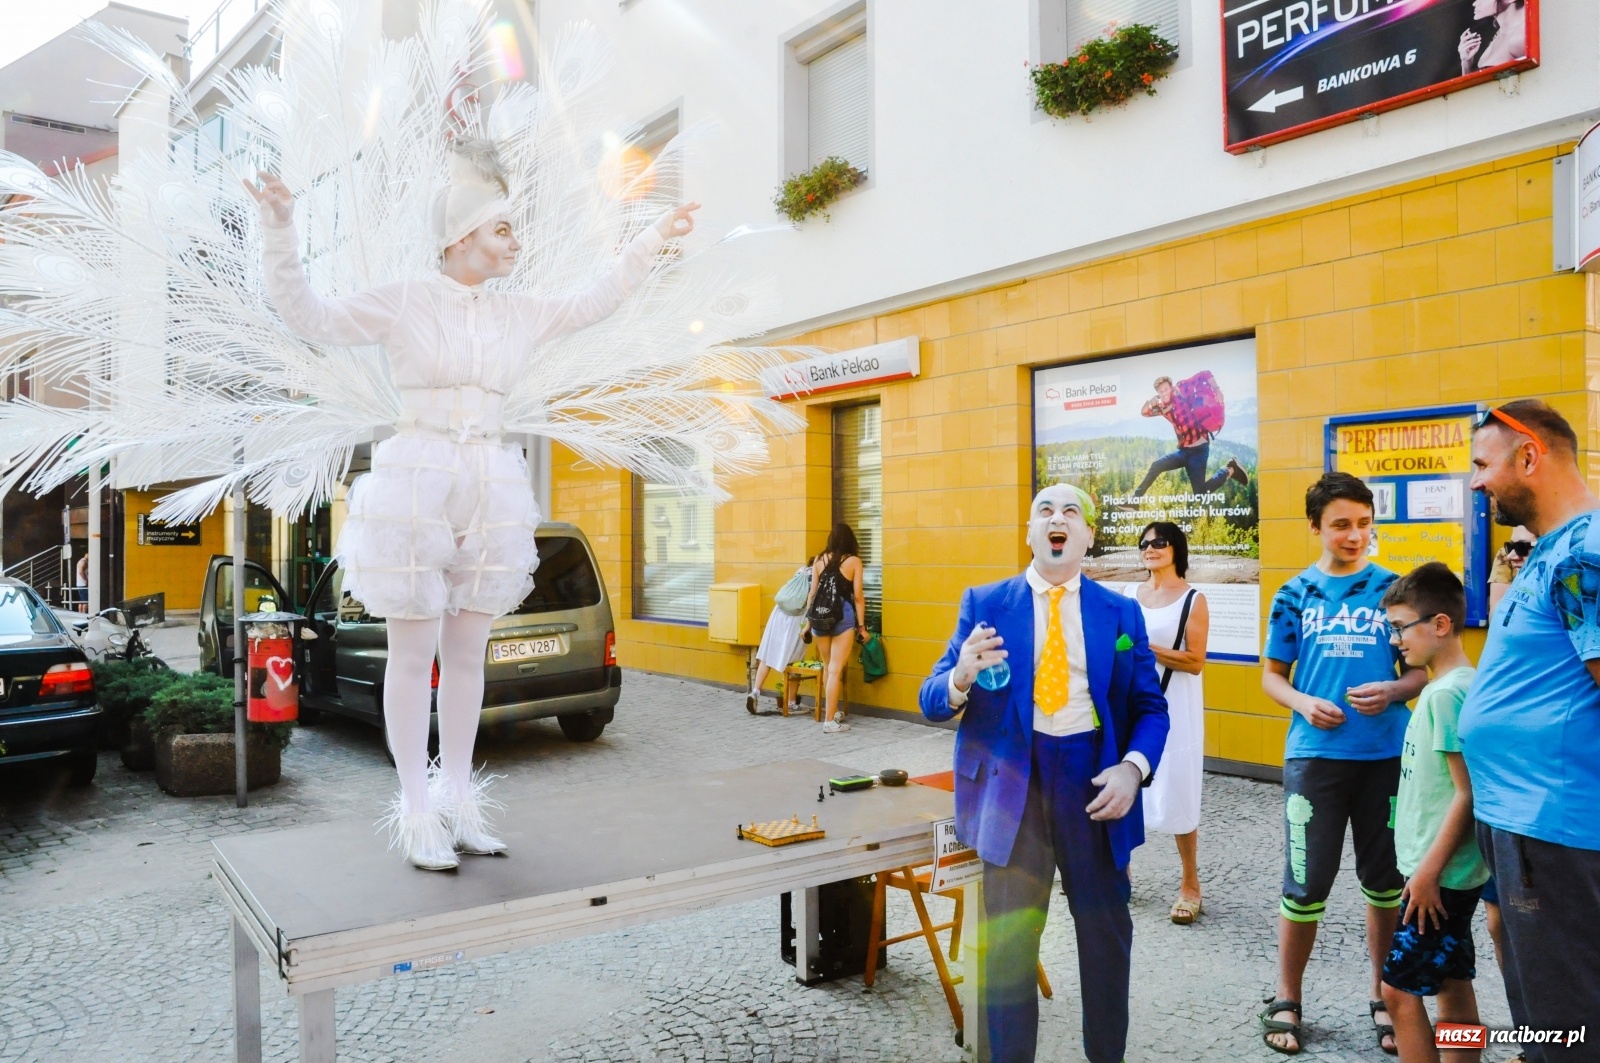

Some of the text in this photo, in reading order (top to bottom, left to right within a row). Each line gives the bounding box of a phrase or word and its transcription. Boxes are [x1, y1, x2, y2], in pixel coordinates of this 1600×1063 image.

[1317, 48, 1417, 94] BANKOWA 6
[810, 356, 880, 382] Bank Pekao
[1065, 383, 1117, 398] Bank Pekao
[1342, 422, 1465, 455] PERFUMERIA
[1047, 463, 1057, 471] ILE
[1425, 485, 1447, 494] HEAN
[1103, 490, 1226, 507] Płać kartą rewolucyjną
[1103, 504, 1251, 522] z gwarancją niskich kursów
[1103, 526, 1116, 534] na
[1421, 531, 1452, 548] Pudry
[1302, 602, 1387, 639] BLACK
[1347, 635, 1369, 643] DENIM
[501, 640, 556, 657] SRC V287
